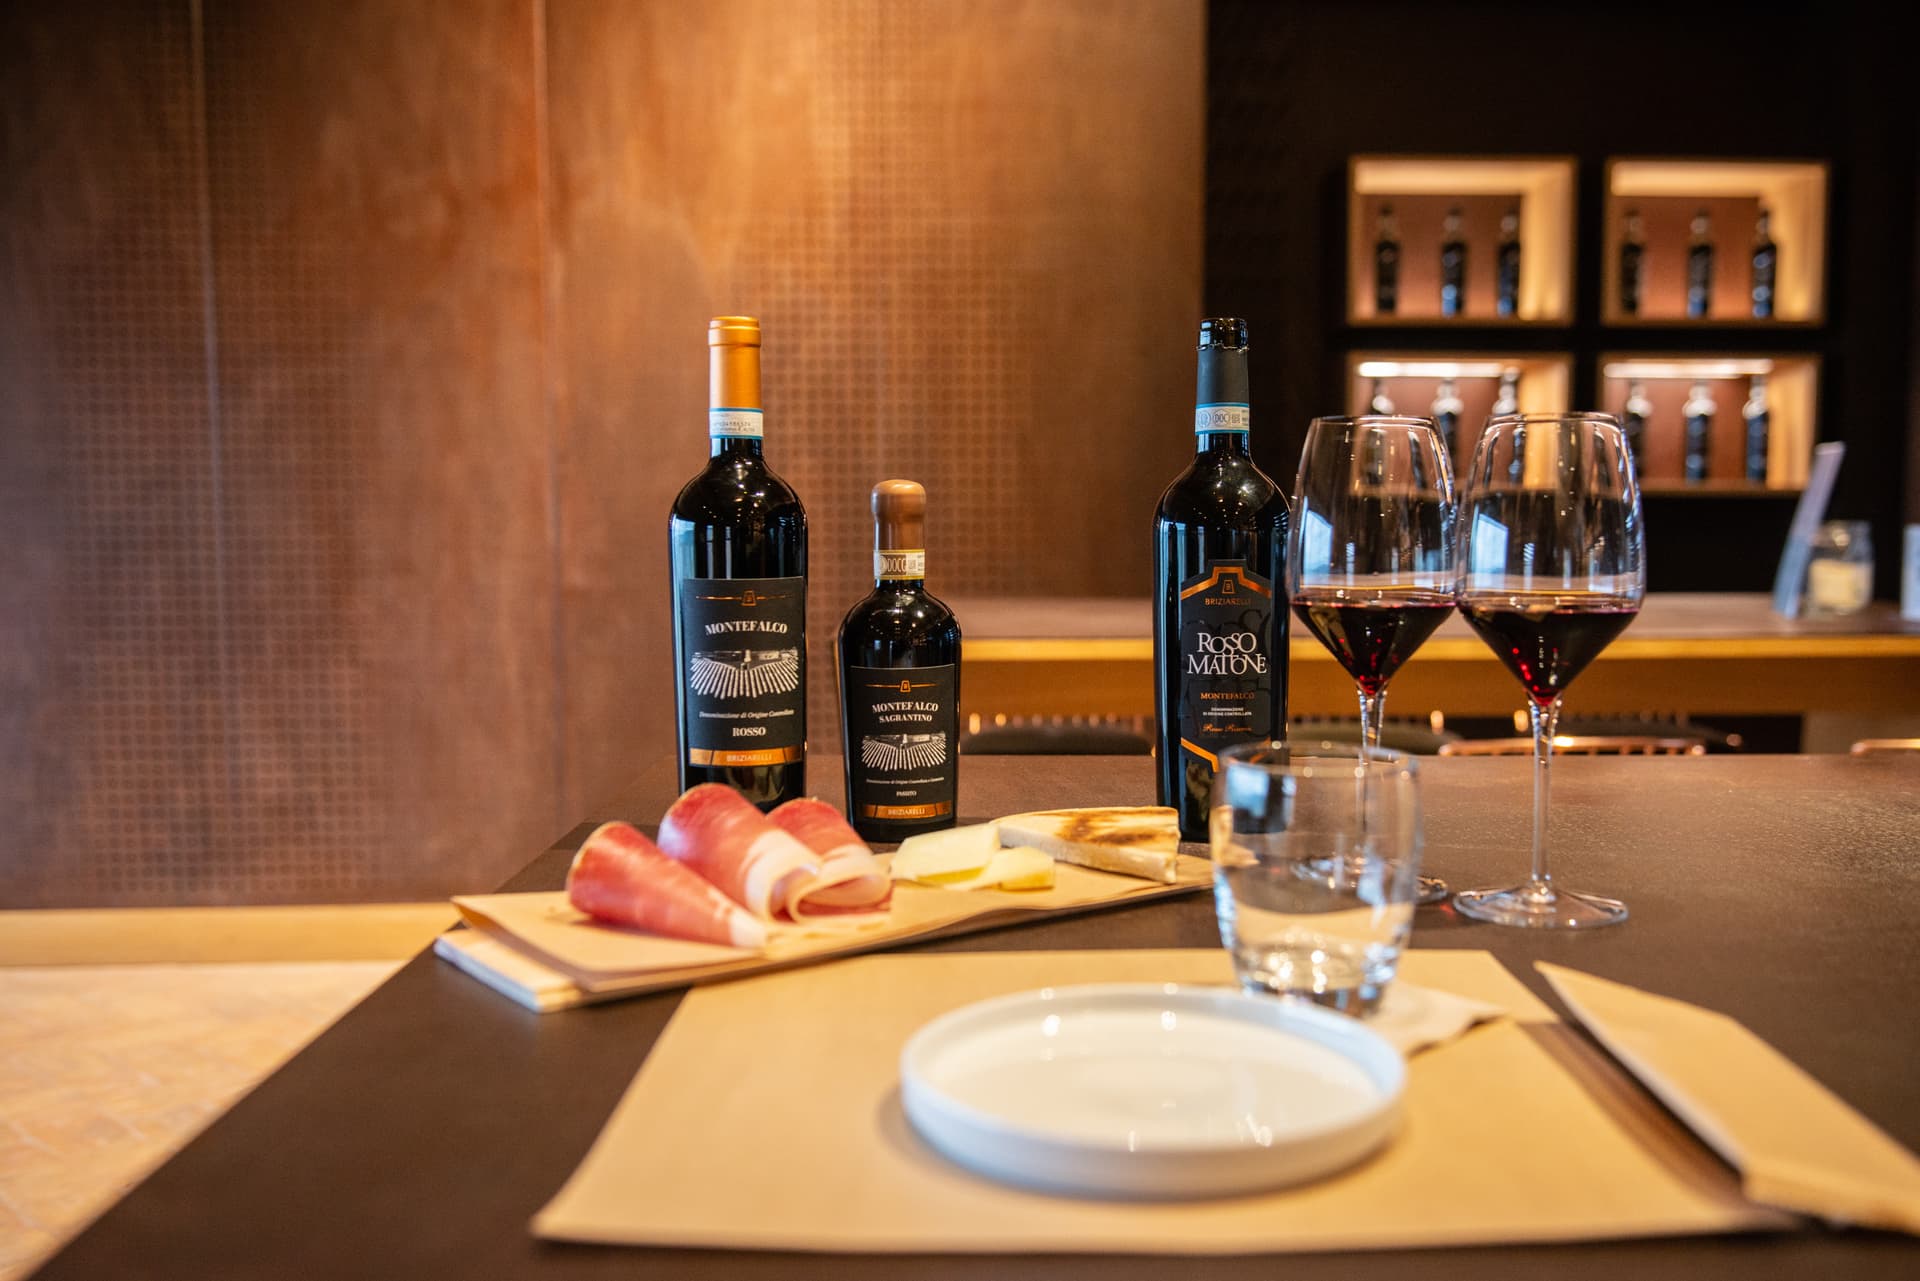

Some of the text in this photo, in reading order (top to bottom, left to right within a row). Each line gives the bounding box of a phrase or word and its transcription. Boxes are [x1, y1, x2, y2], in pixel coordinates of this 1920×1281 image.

[705, 621, 788, 634] MONTEFALCO
[1197, 632, 1257, 656] ROSSO
[1187, 653, 1267, 675] MATTONE
[1200, 692, 1255, 700] MONTEFALCO
[872, 701, 939, 713] MONTEFALCO
[879, 713, 933, 723] SAGRANTINO
[732, 727, 766, 737] ROSSO
[726, 754, 772, 762] BRIZIARELLI
